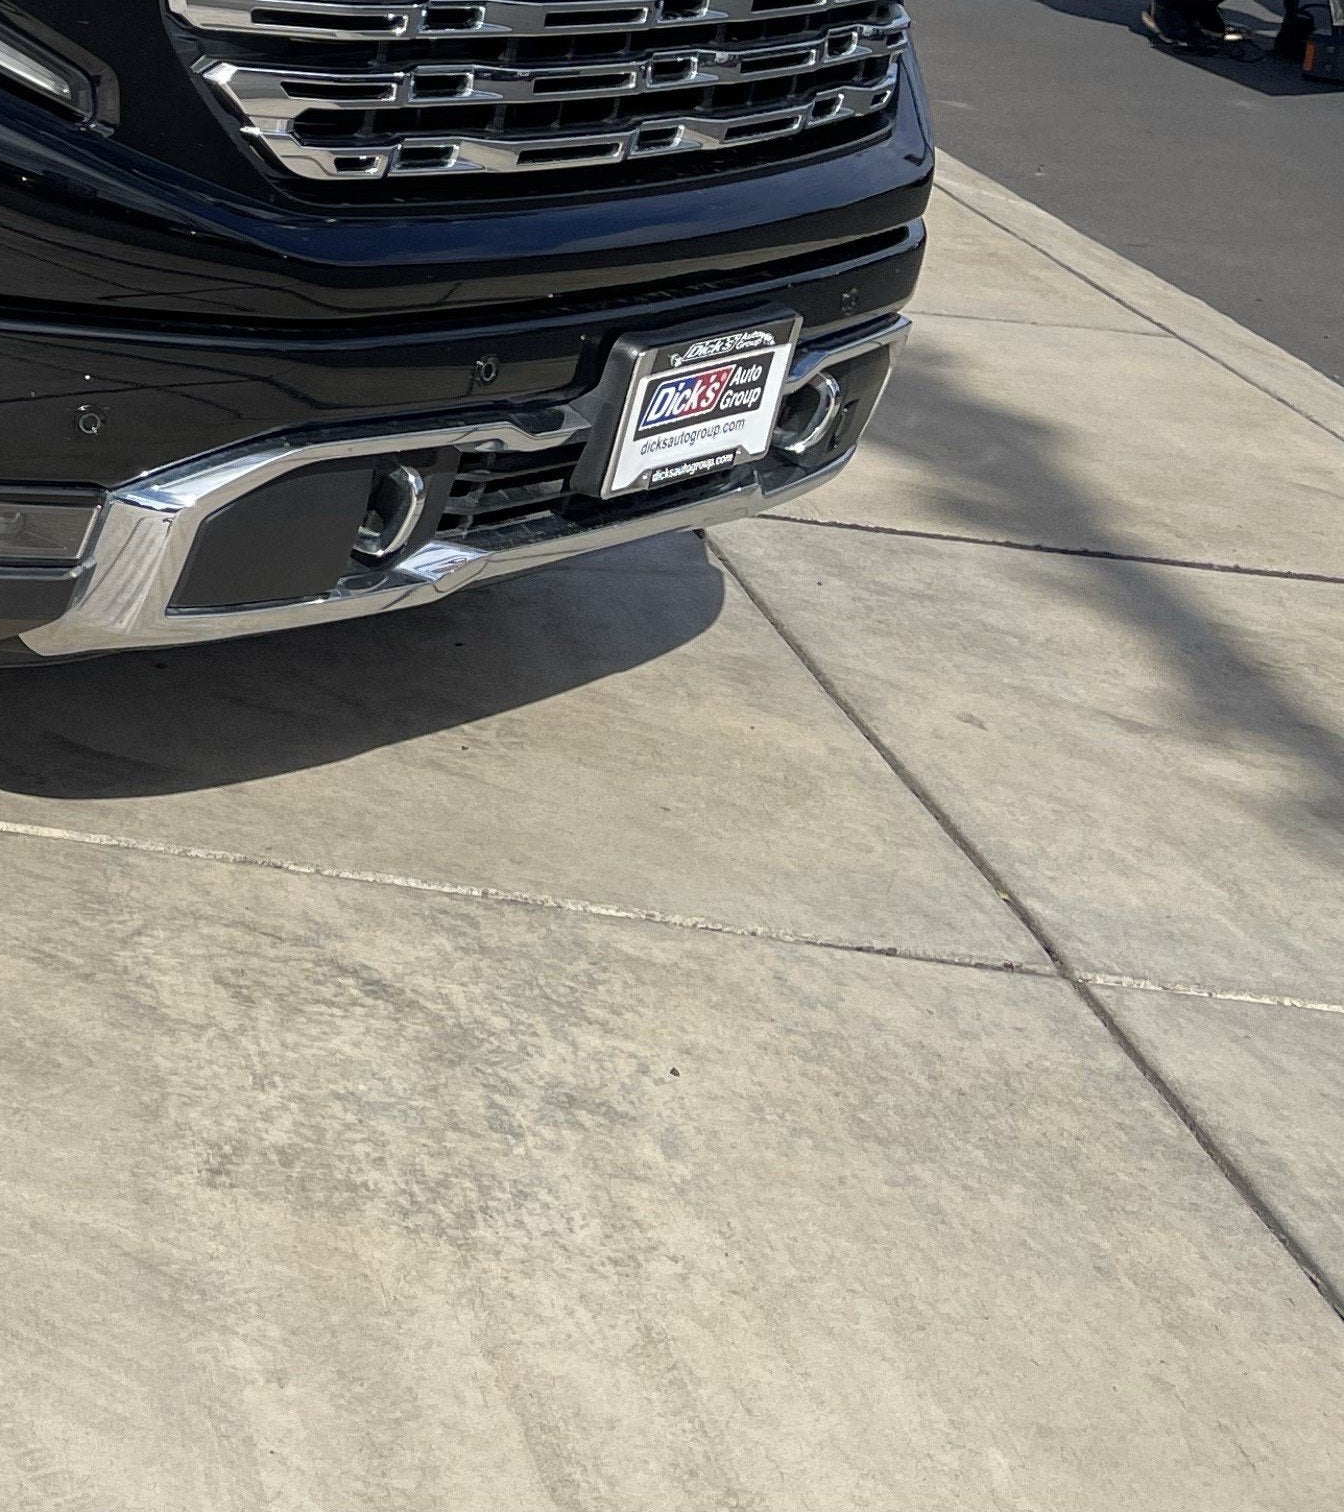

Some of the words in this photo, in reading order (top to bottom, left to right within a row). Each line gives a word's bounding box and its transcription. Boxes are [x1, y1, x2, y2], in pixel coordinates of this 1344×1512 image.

[729, 364, 763, 386] Auto
[720, 387, 762, 410] Group
[640, 419, 745, 455] dicksautogroup.com
[652, 453, 734, 482] dicksautogroup.com
